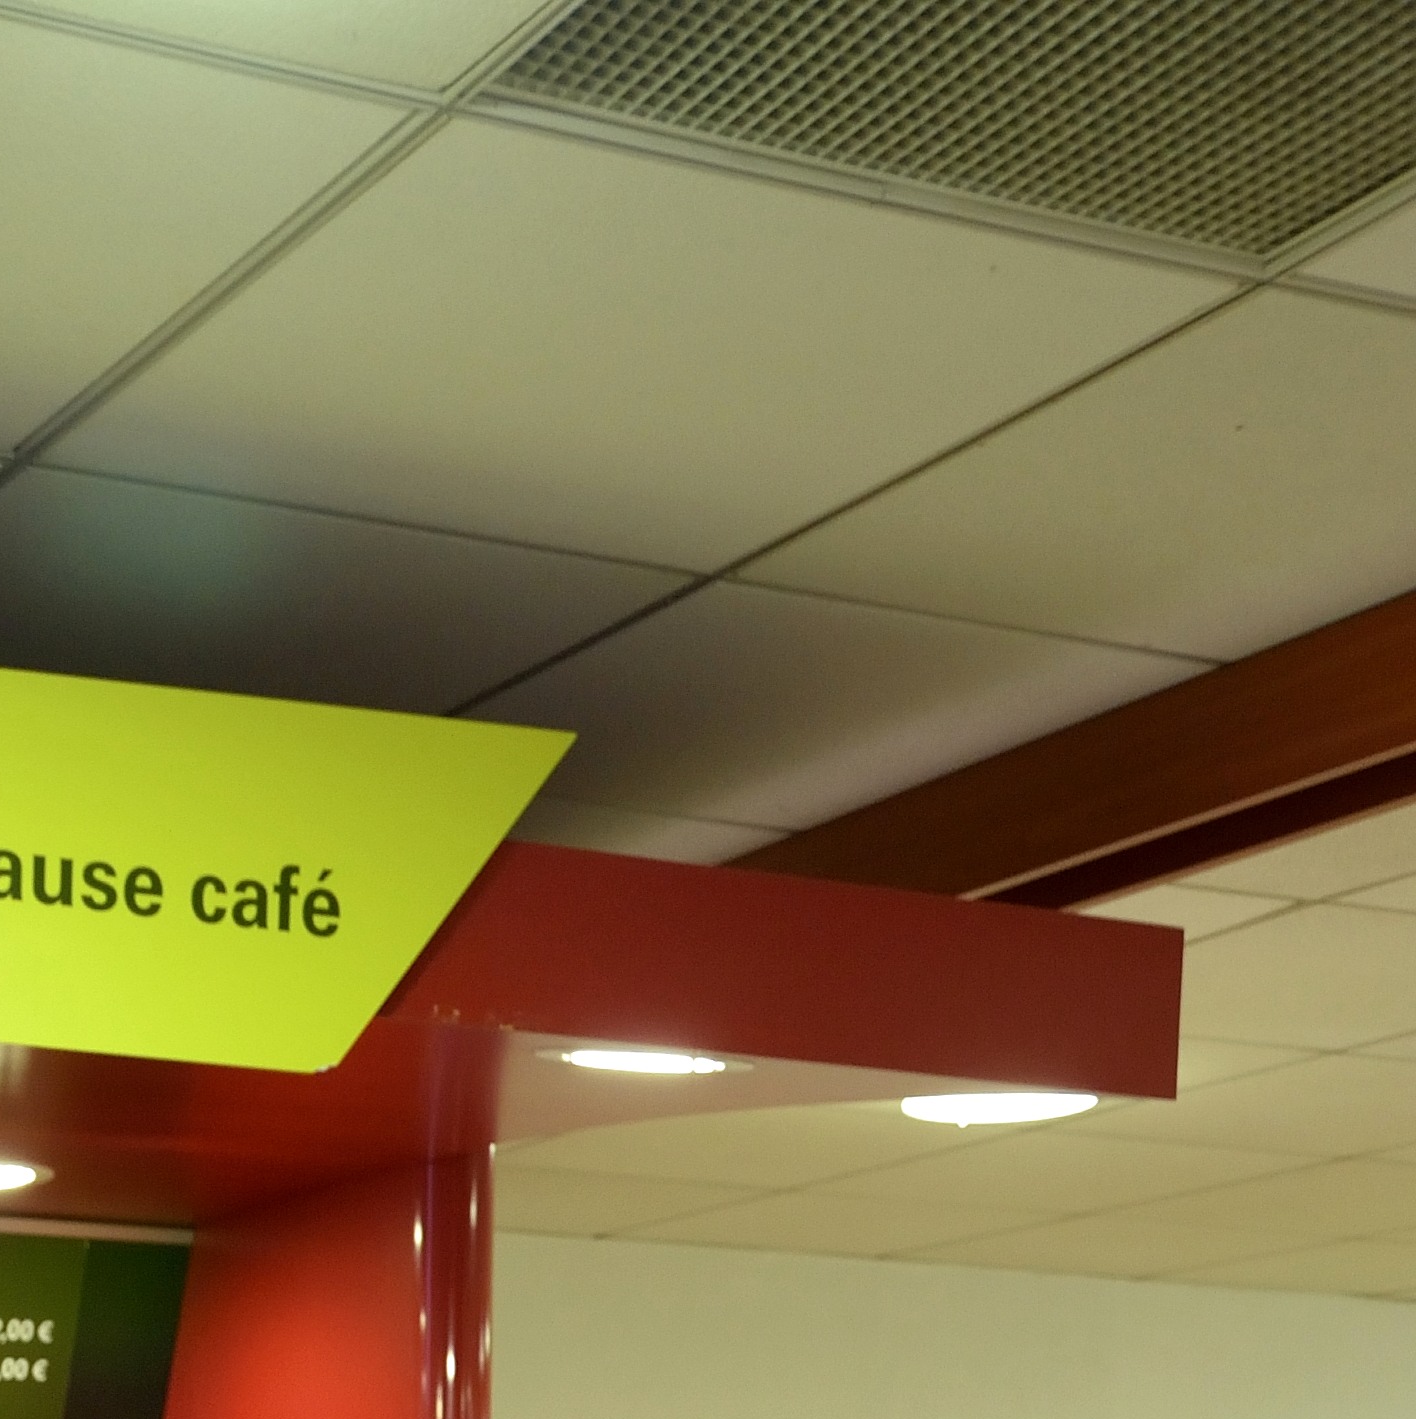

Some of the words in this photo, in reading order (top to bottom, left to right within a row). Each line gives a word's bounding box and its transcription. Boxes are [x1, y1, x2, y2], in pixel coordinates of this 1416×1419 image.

[191, 864, 341, 938] café
[37, 1320, 54, 1344] €
[30, 1358, 48, 1382] €
